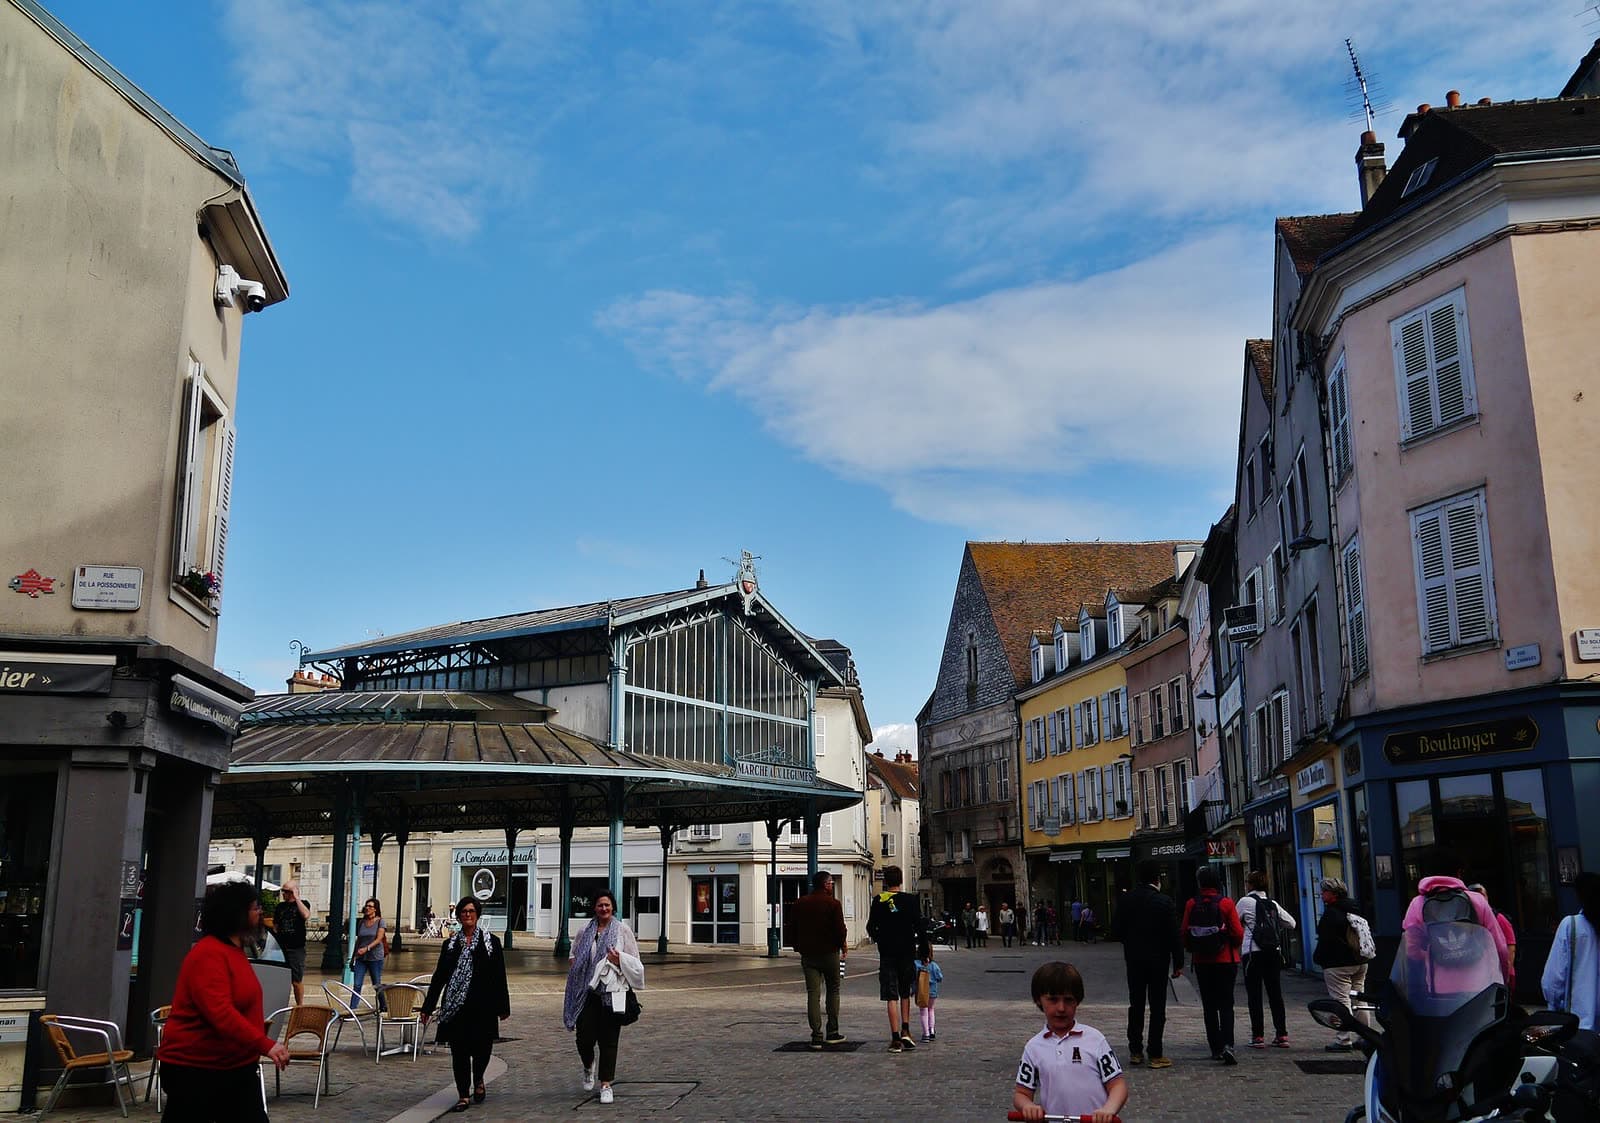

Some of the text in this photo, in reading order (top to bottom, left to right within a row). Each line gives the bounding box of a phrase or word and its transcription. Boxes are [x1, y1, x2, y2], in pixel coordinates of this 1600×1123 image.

[1418, 730, 1497, 754] Boulanger
[1072, 1046, 1082, 1060] A
[1020, 1062, 1033, 1084] S
[1100, 1054, 1116, 1078] R
